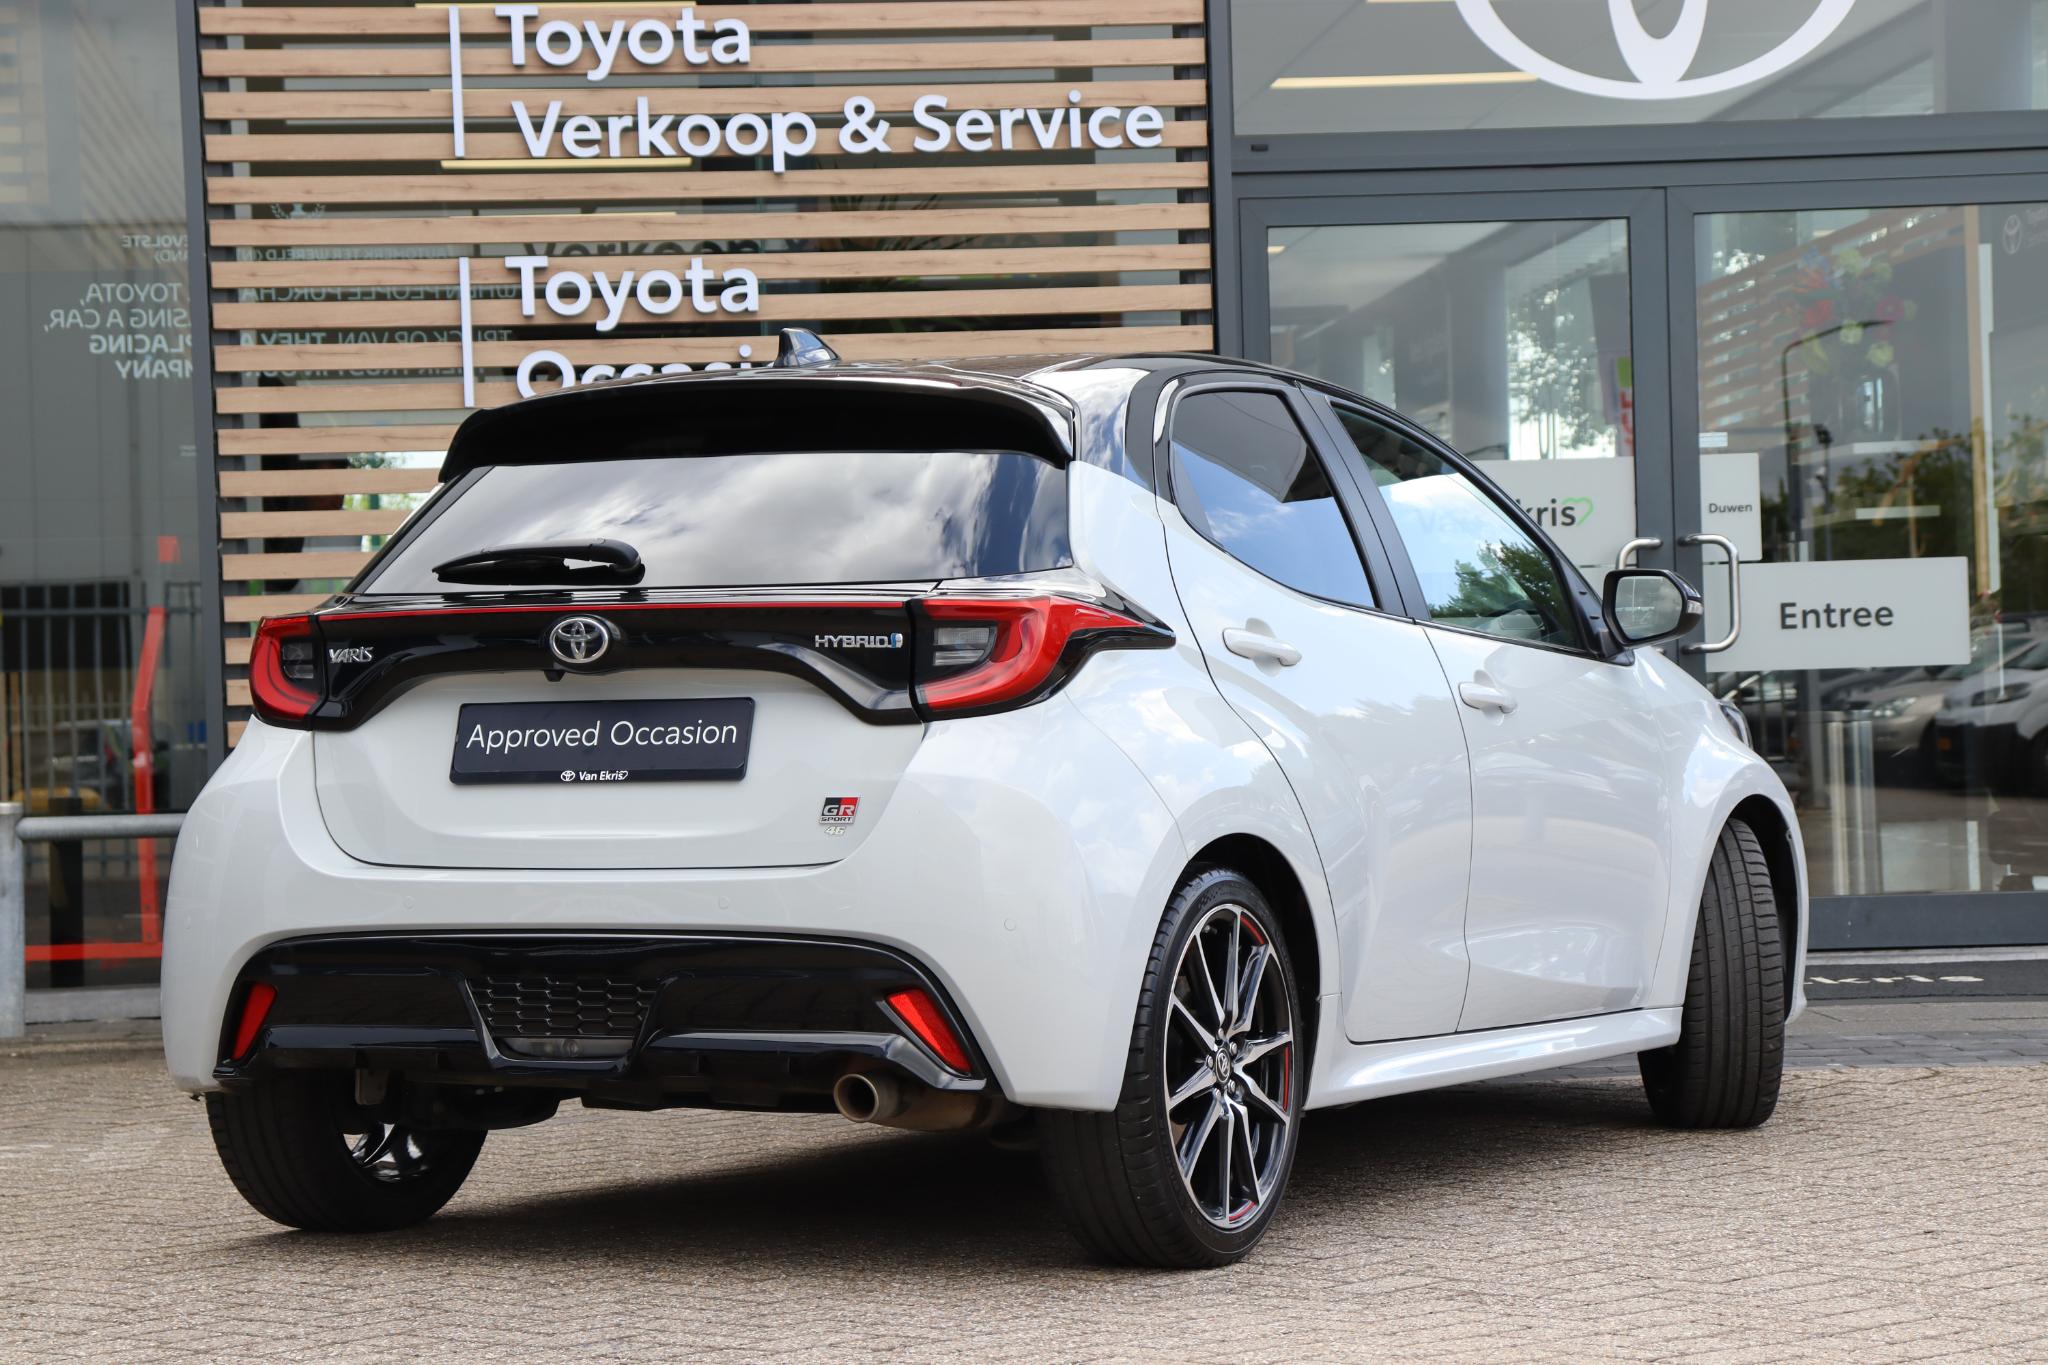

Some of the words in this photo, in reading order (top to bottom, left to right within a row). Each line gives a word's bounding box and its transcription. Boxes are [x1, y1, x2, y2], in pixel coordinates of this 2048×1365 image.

[494, 5, 751, 81] Toyota
[511, 96, 817, 174] Verkoop
[838, 95, 893, 154] &
[912, 89, 1165, 152] Service
[504, 255, 759, 332] Toyota
[1708, 502, 1753, 514] Duwen
[1780, 602, 1894, 630] Entree
[814, 635, 890, 649] HYBRID
[466, 720, 601, 755] Approved
[610, 719, 737, 746] Occasion
[579, 770, 598, 781] Van
[599, 770, 624, 781] Ekris
[823, 804, 856, 816] GR
